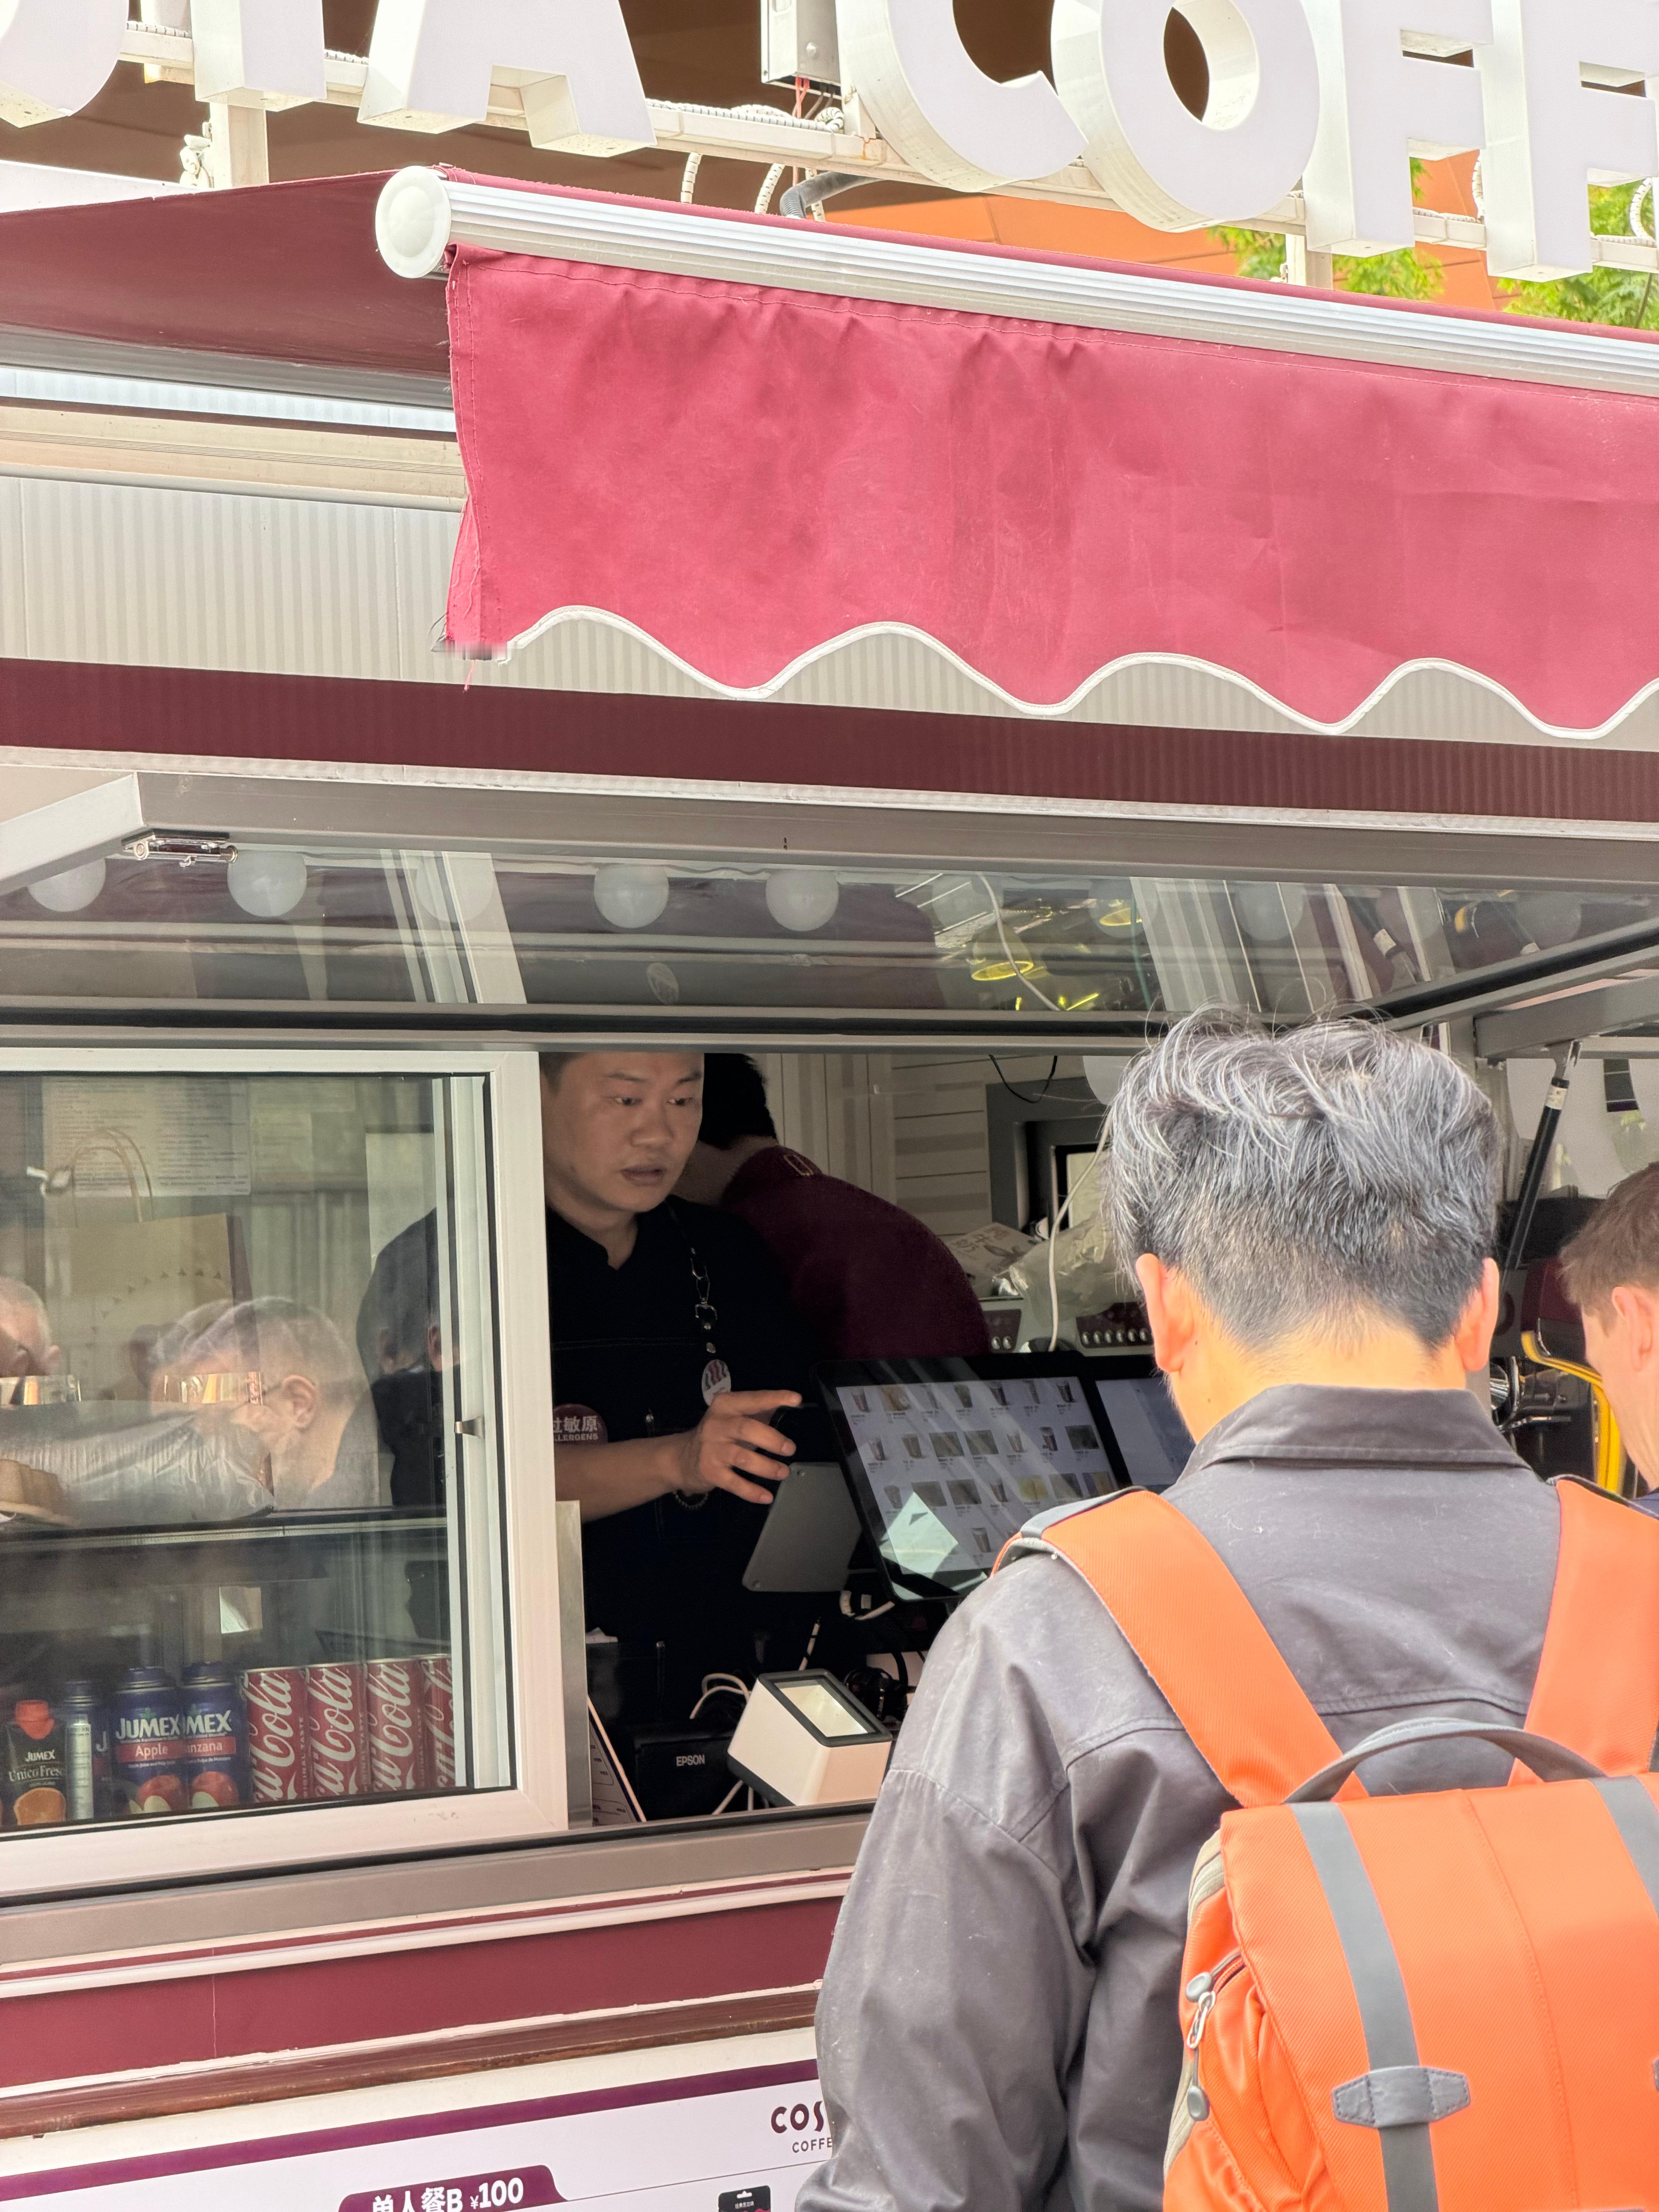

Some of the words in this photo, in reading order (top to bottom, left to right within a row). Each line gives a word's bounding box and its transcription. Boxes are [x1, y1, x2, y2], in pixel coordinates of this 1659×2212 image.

[116, 1714, 180, 1739] JUMEX
[25, 1749, 55, 1762] JUMEX
[136, 1743, 168, 1759] Apple
[676, 1755, 705, 1767] EPSON
[470, 2178, 524, 2209] ¥100
